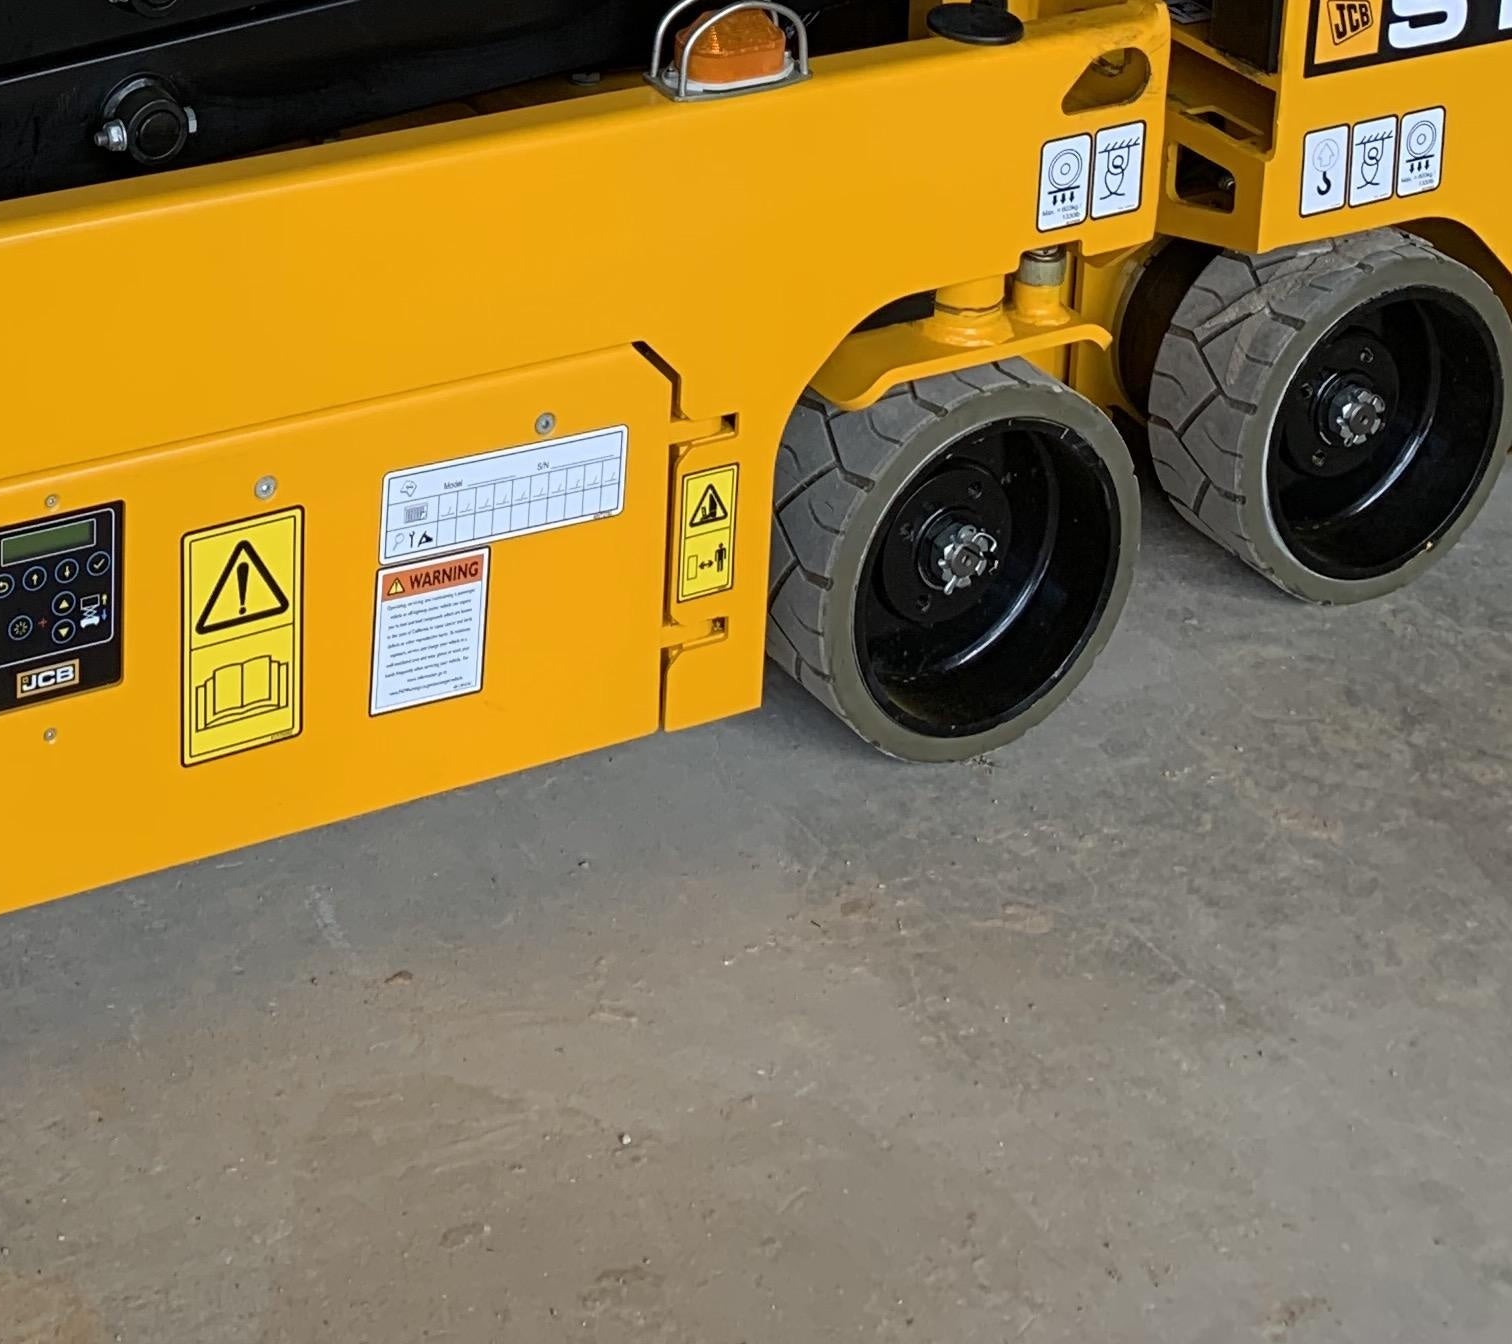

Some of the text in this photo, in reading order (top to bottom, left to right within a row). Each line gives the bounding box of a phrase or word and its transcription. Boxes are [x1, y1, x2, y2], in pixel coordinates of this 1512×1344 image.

[1331, 1, 1372, 41] JCB
[536, 461, 550, 472] S/N
[443, 479, 464, 491] Model
[409, 560, 479, 590] WARNING
[21, 664, 75, 692] JCB
